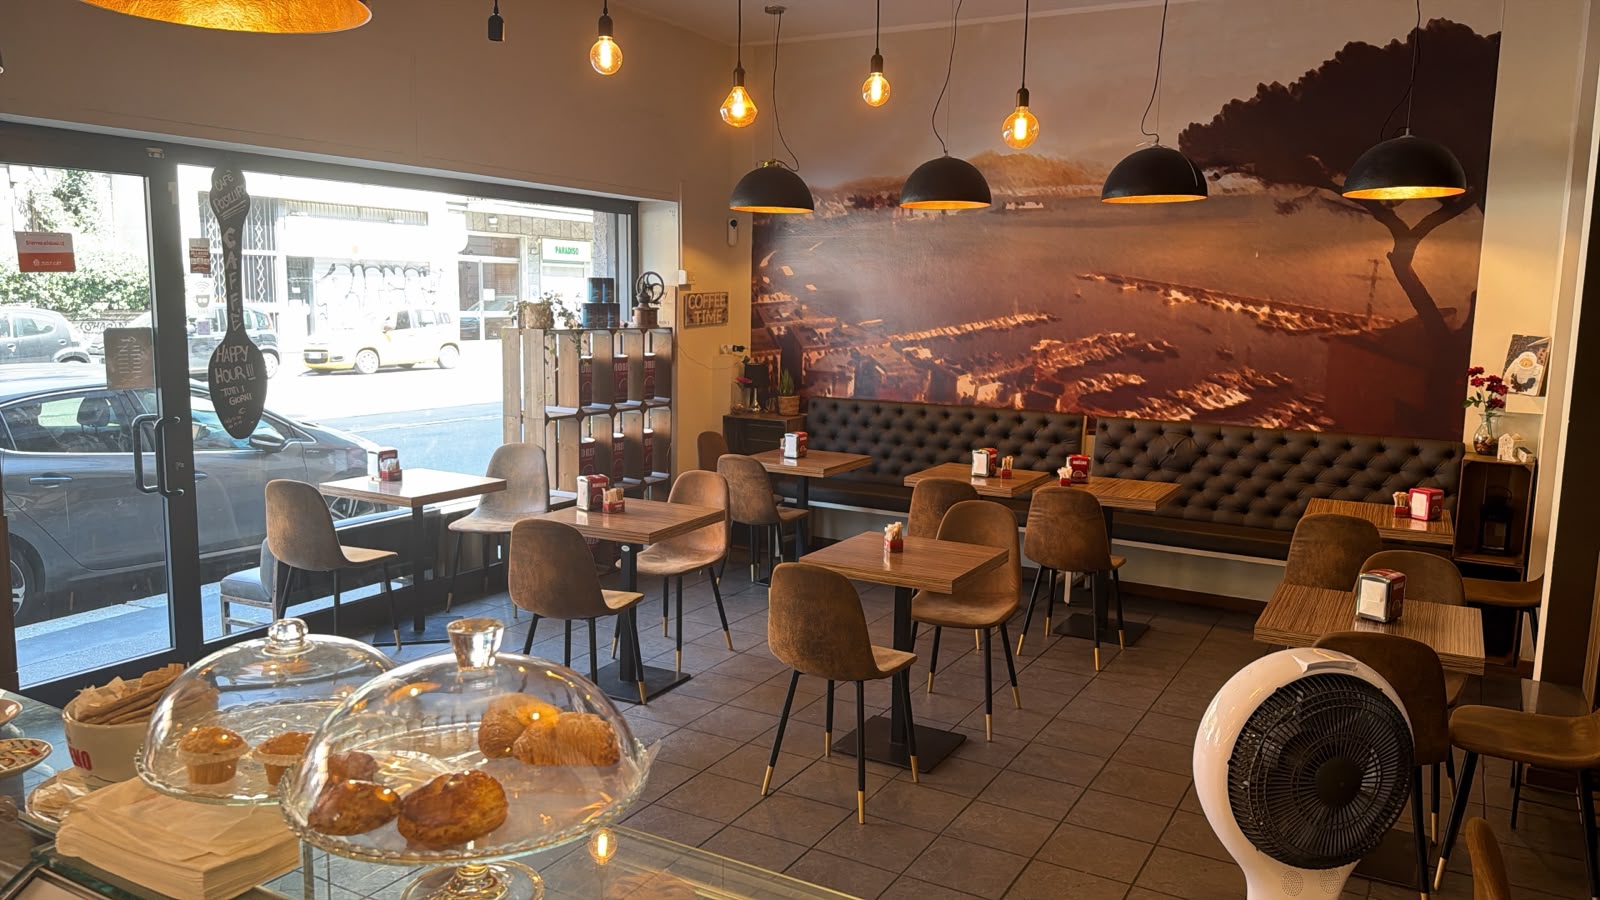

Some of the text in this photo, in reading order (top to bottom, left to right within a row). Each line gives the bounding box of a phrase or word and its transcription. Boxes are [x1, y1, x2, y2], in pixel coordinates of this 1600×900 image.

[555, 246, 579, 255] PARADISO
[688, 293, 727, 309] COFFEE
[694, 308, 723, 325] TIME
[215, 345, 249, 363] HAPPY
[229, 394, 252, 405] GIORNI
